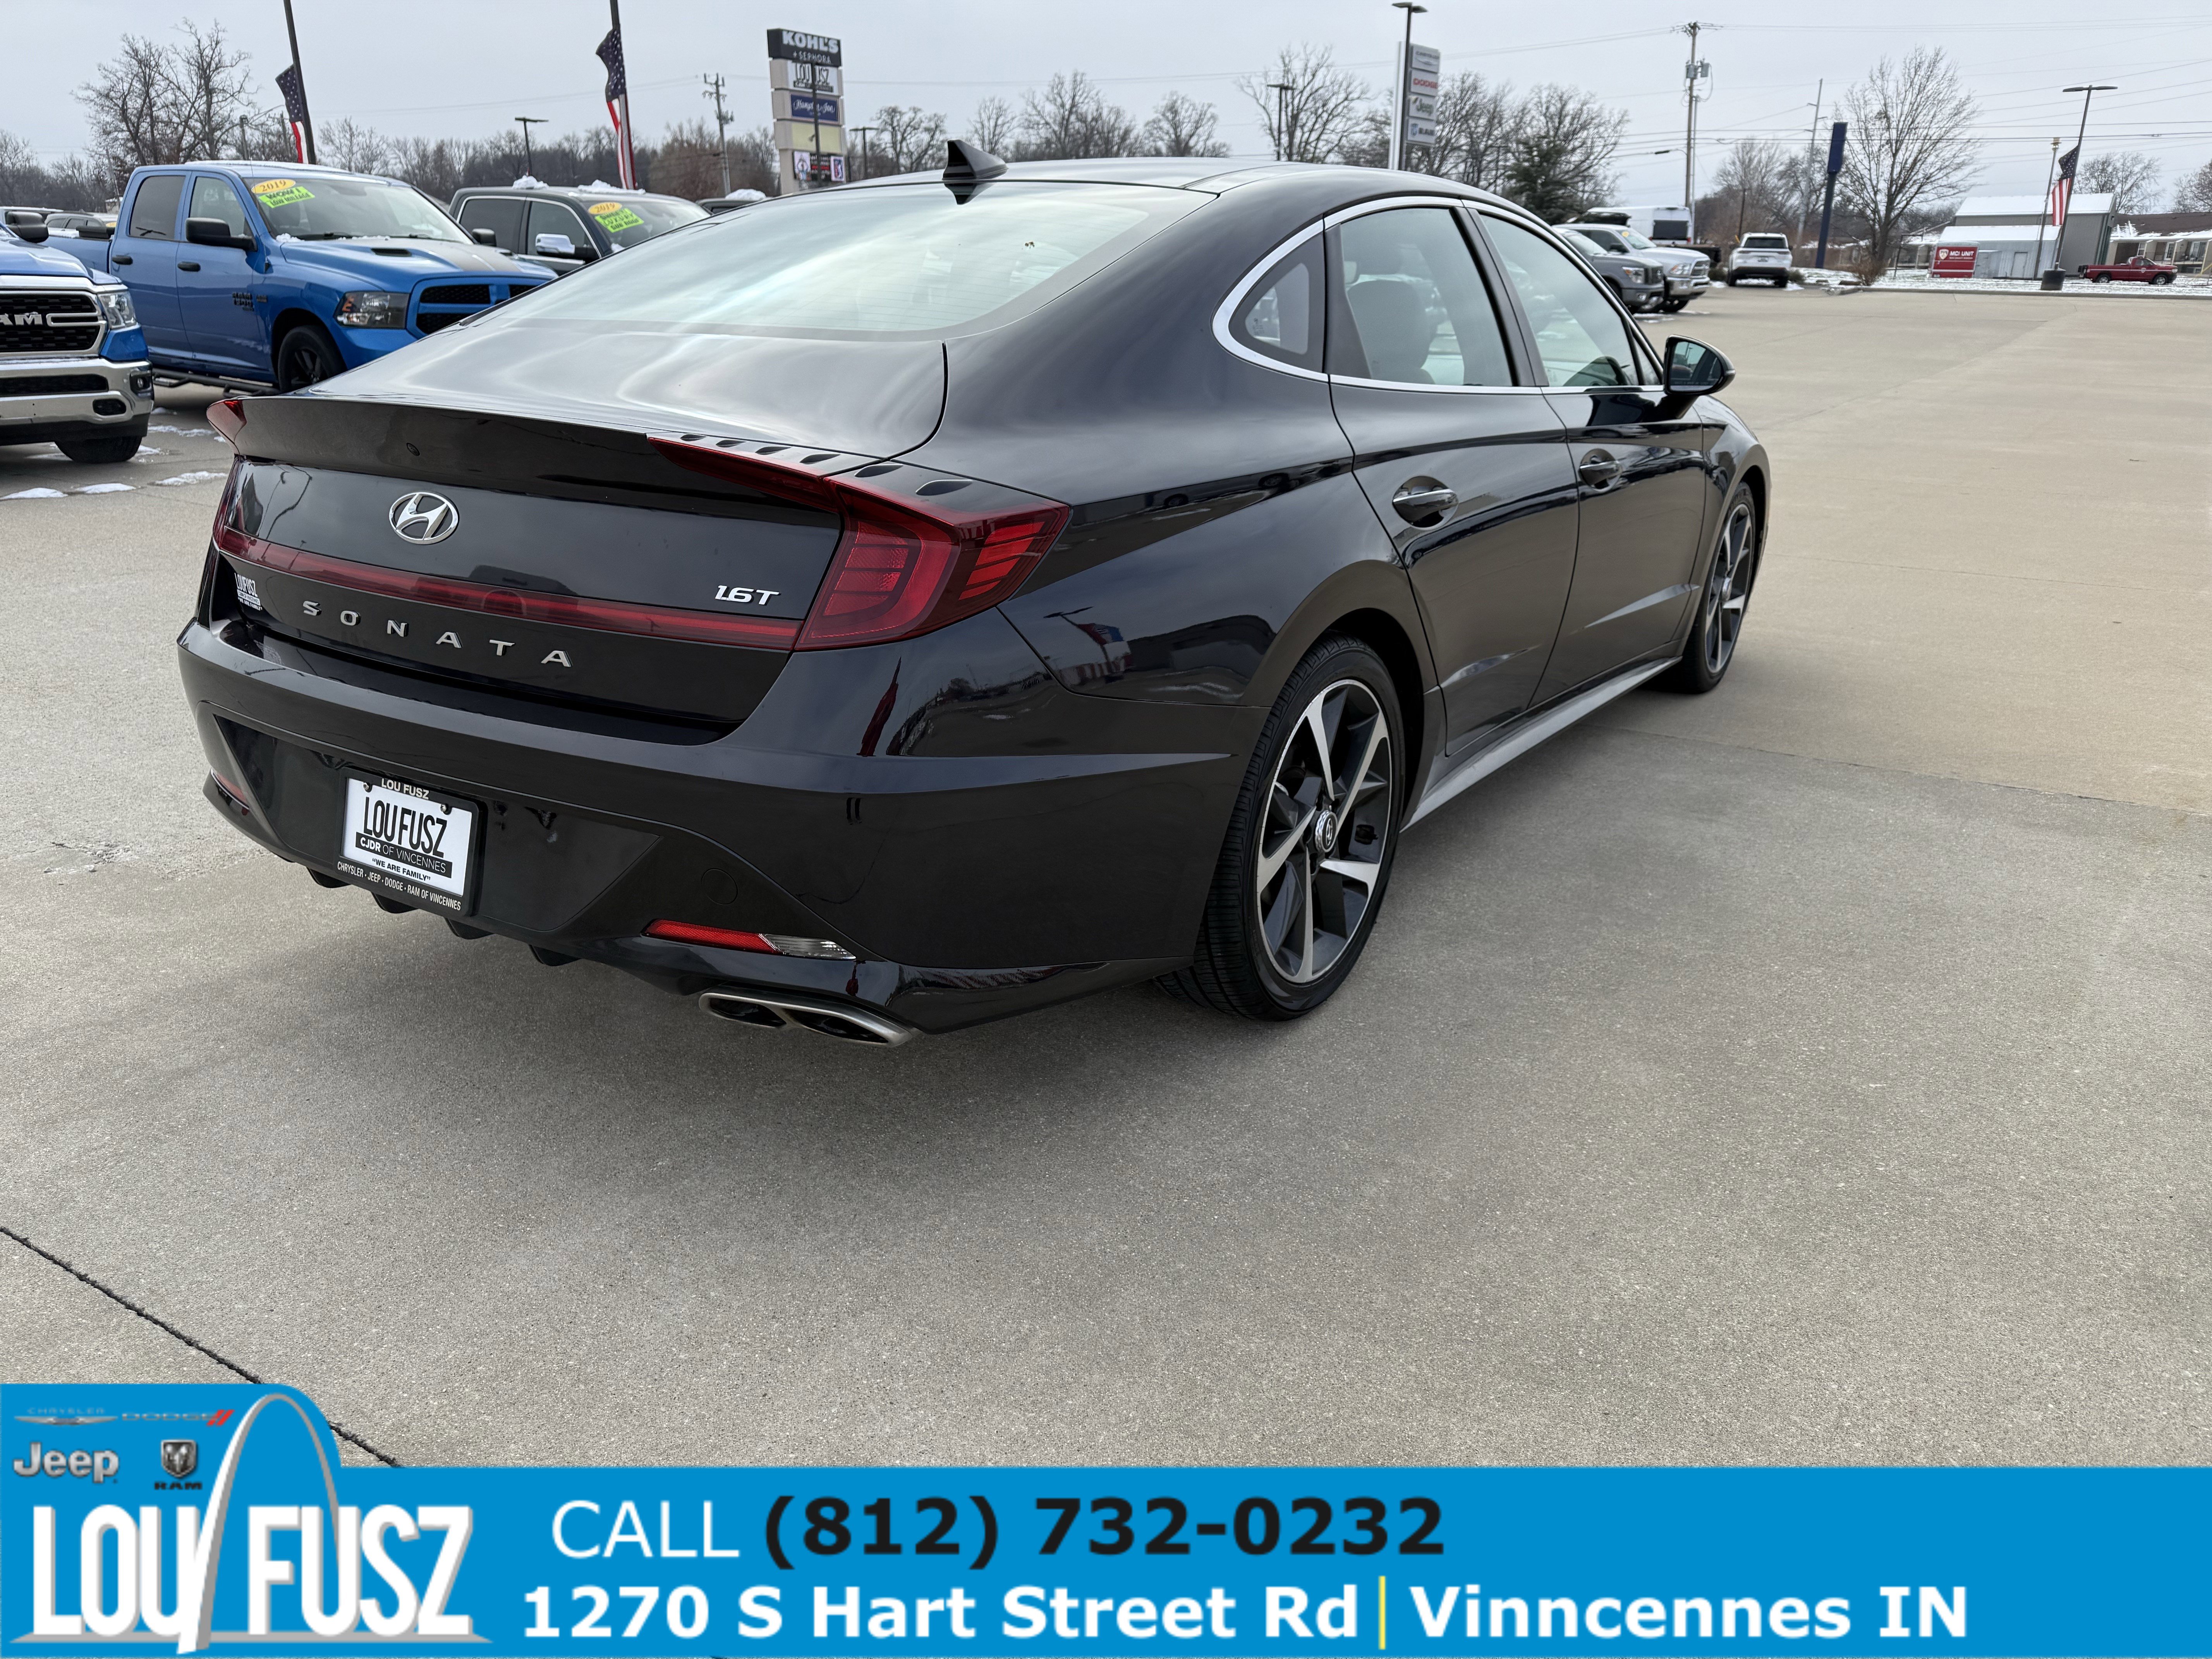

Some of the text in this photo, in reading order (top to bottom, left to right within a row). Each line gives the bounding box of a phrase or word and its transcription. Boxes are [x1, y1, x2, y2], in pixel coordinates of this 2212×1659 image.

[782, 31, 839, 53] KOHL'S
[798, 51, 831, 64] SEPHORA
[259, 180, 286, 192] 2019
[715, 585, 780, 605] 1.6T
[303, 600, 573, 668] SONATA
[381, 778, 429, 800] LOU FUSZ
[360, 836, 446, 873] CJDR OF VINCENNES
[387, 862, 401, 873] ARE
[337, 860, 461, 911] CHRYSLER JEEP DODGE RAM OF VINCENNES
